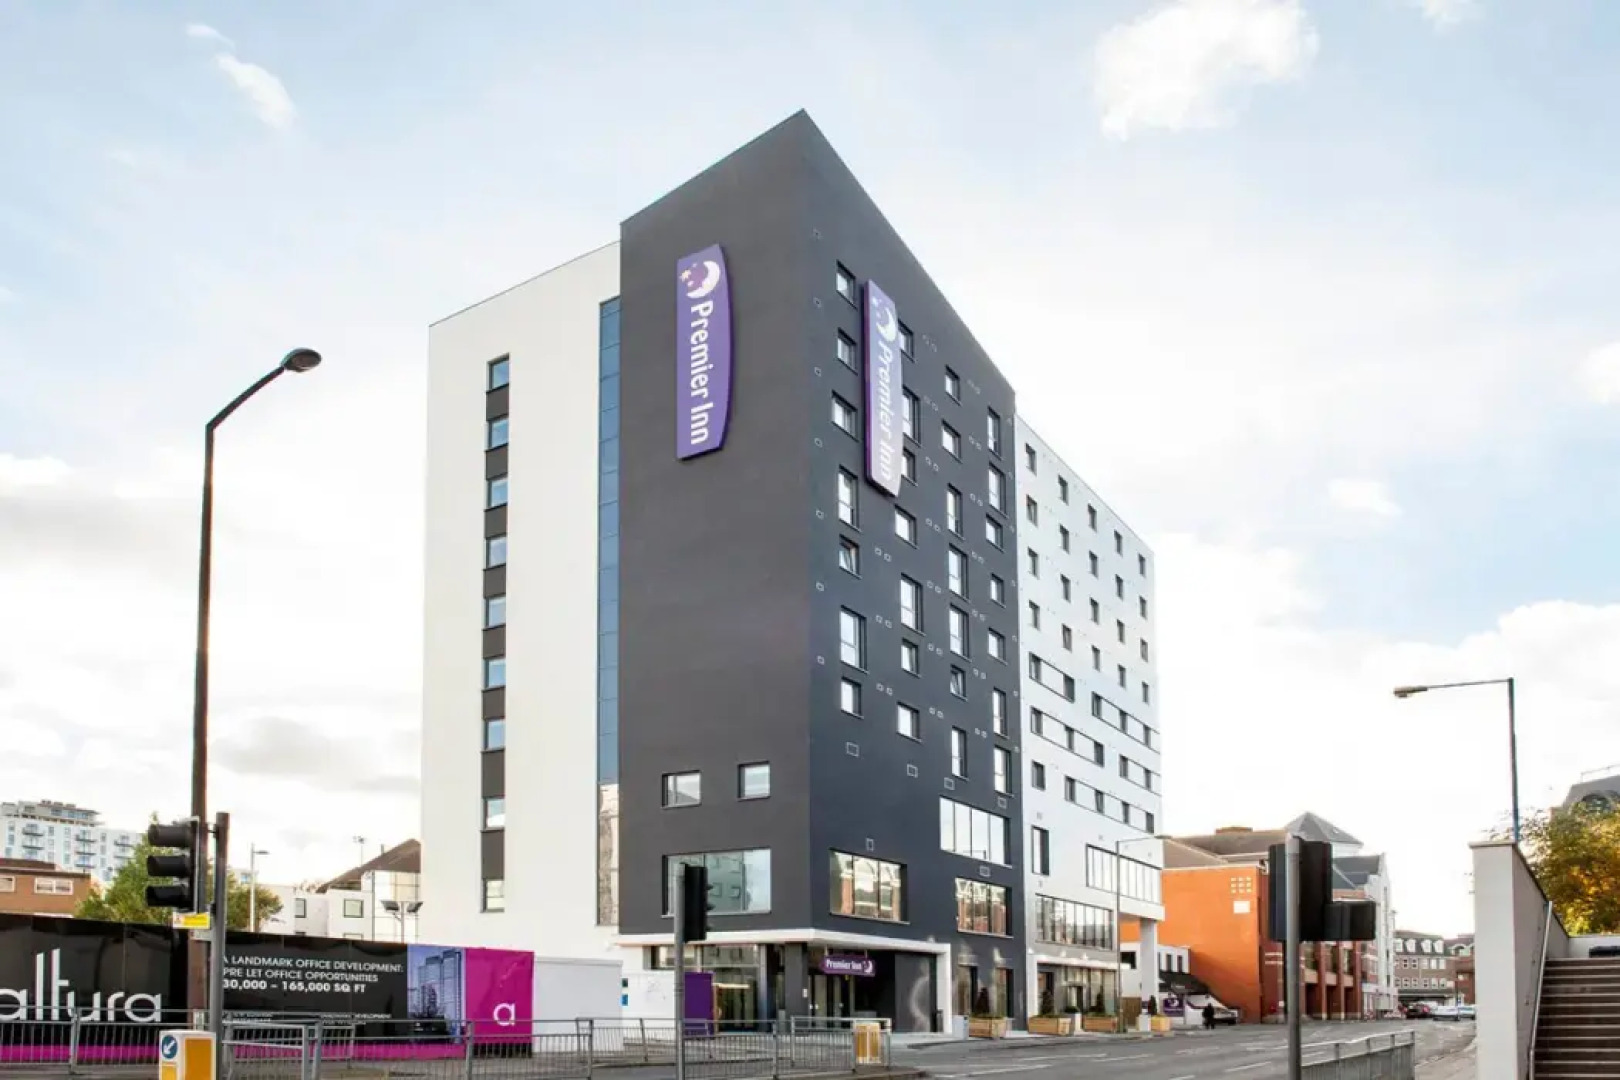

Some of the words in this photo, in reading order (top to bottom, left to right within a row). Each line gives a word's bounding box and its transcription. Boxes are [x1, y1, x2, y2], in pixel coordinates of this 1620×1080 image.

[690, 300, 714, 398] Premier
[877, 340, 895, 440] Premier
[690, 402, 714, 445] Inn
[879, 440, 895, 481] Inn
[223, 967, 243, 977] PRE
[246, 968, 263, 978] LET
[264, 969, 302, 979] OFFICE
[304, 971, 379, 982] OPPORTUNITIES
[231, 955, 293, 967] LANDMARK
[295, 959, 331, 970] OFFICE
[826, 959, 851, 970] Premier
[851, 960, 863, 970] Inn
[0, 948, 162, 1022] altura
[281, 980, 331, 993] 165,000
[333, 982, 351, 993] SQ
[353, 983, 367, 993] FT
[493, 1002, 516, 1026] a
